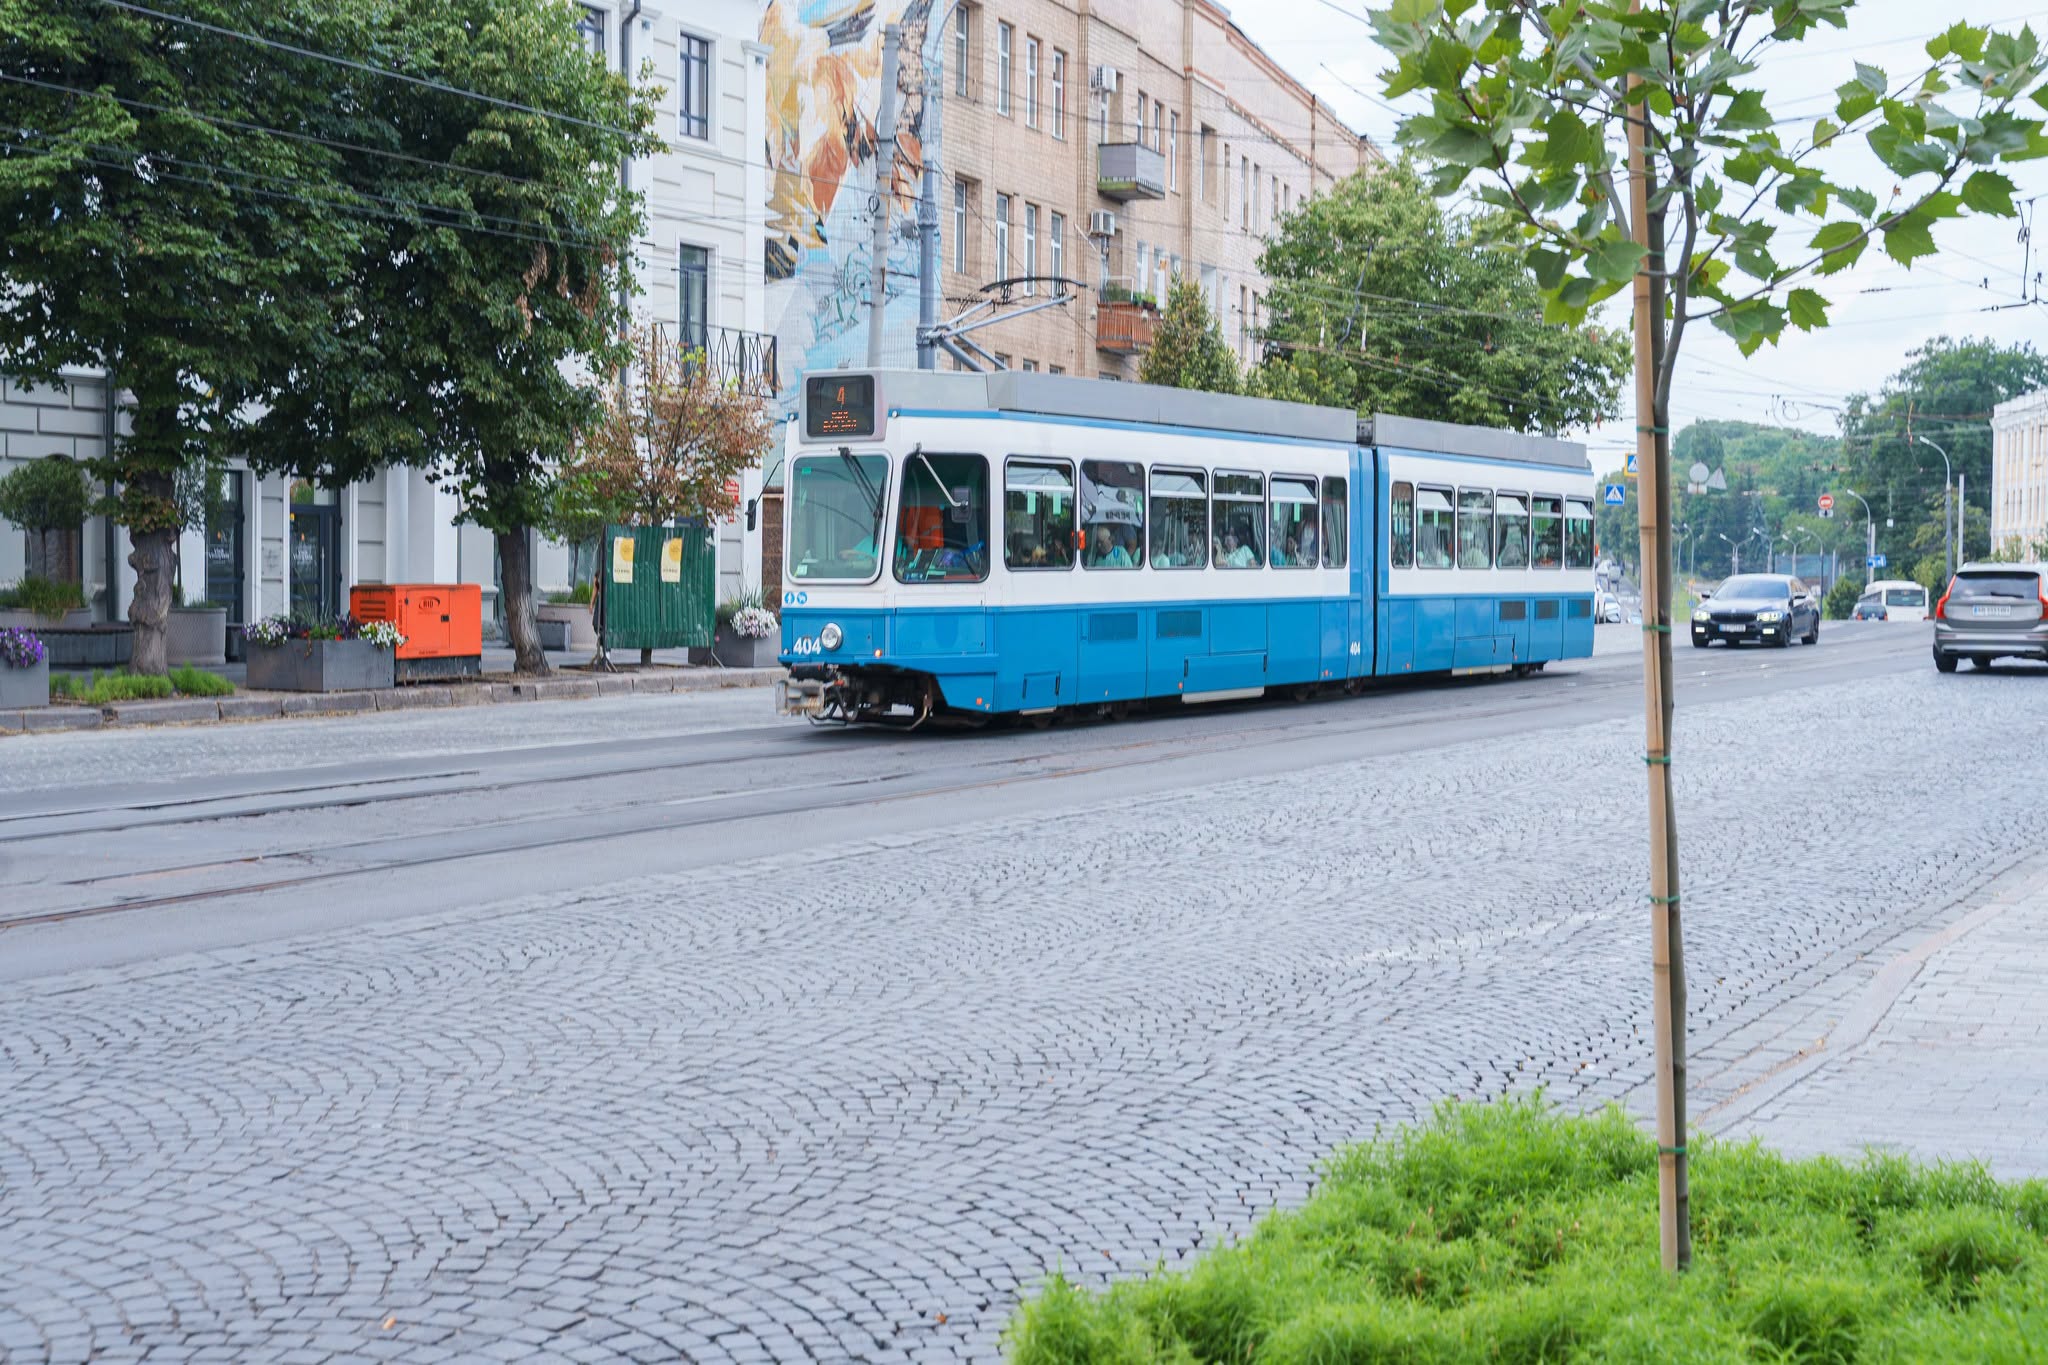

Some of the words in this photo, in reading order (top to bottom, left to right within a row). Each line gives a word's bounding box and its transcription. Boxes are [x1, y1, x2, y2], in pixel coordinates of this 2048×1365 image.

[837, 386, 845, 405] 4
[793, 637, 822, 655] 404
[1350, 641, 1361, 656] 404
